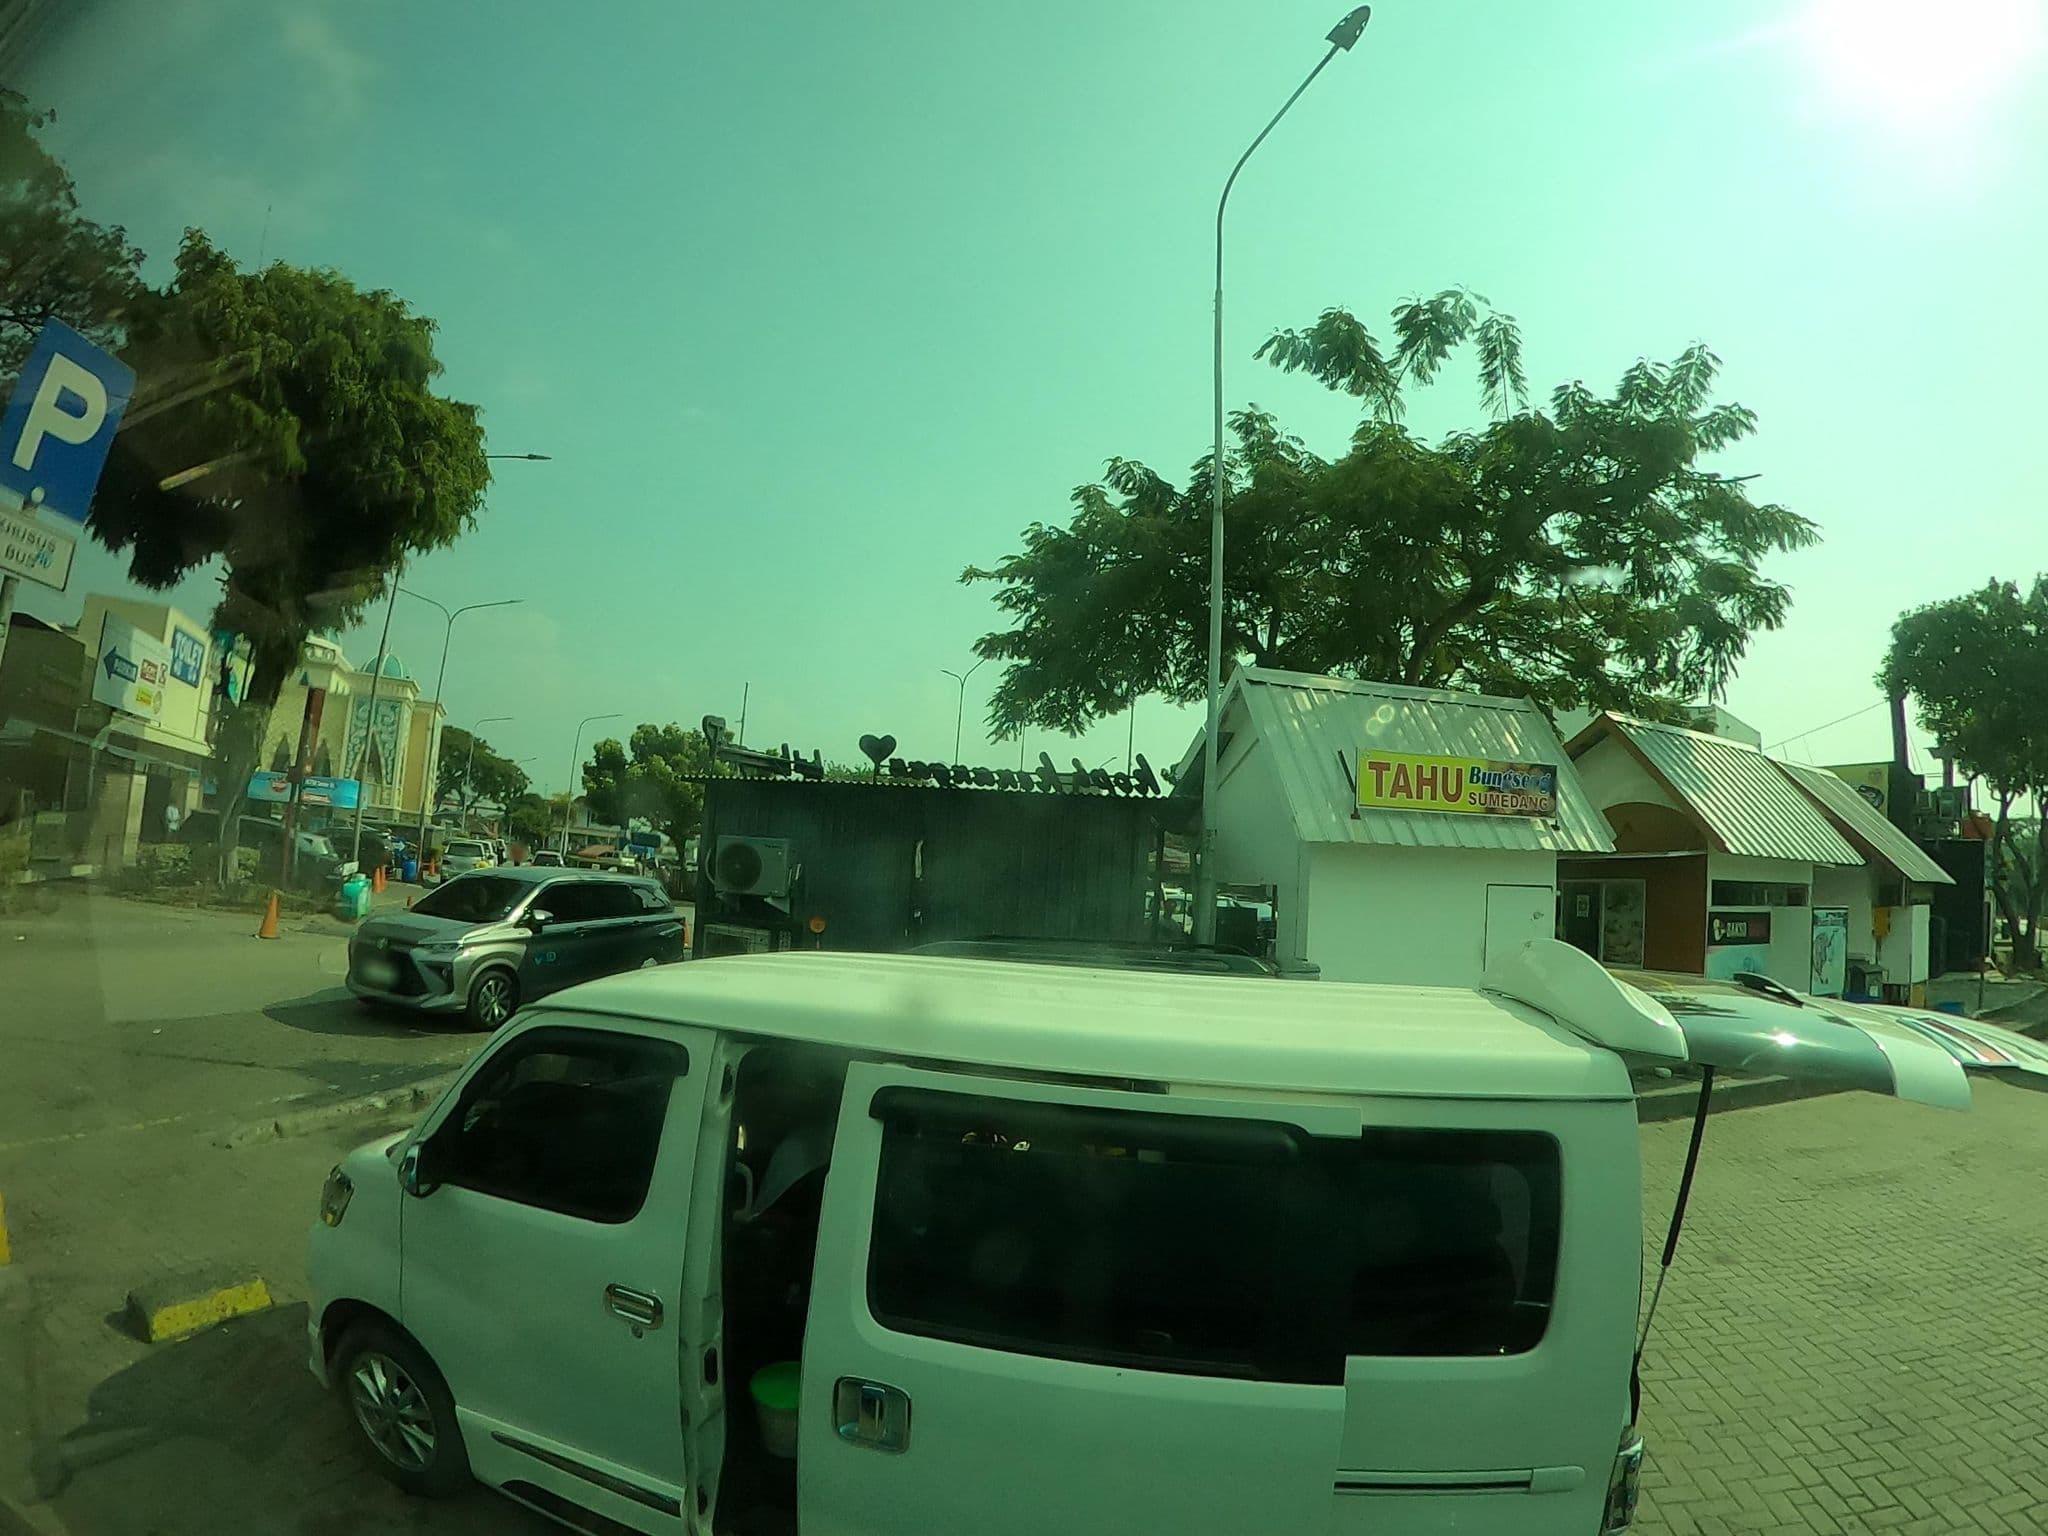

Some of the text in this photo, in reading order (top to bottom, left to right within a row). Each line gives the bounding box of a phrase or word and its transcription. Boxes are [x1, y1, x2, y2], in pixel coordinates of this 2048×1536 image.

[12, 352, 107, 471] P
[1367, 760, 1464, 803] TAHU
[1467, 791, 1549, 811] SUMEDANG
